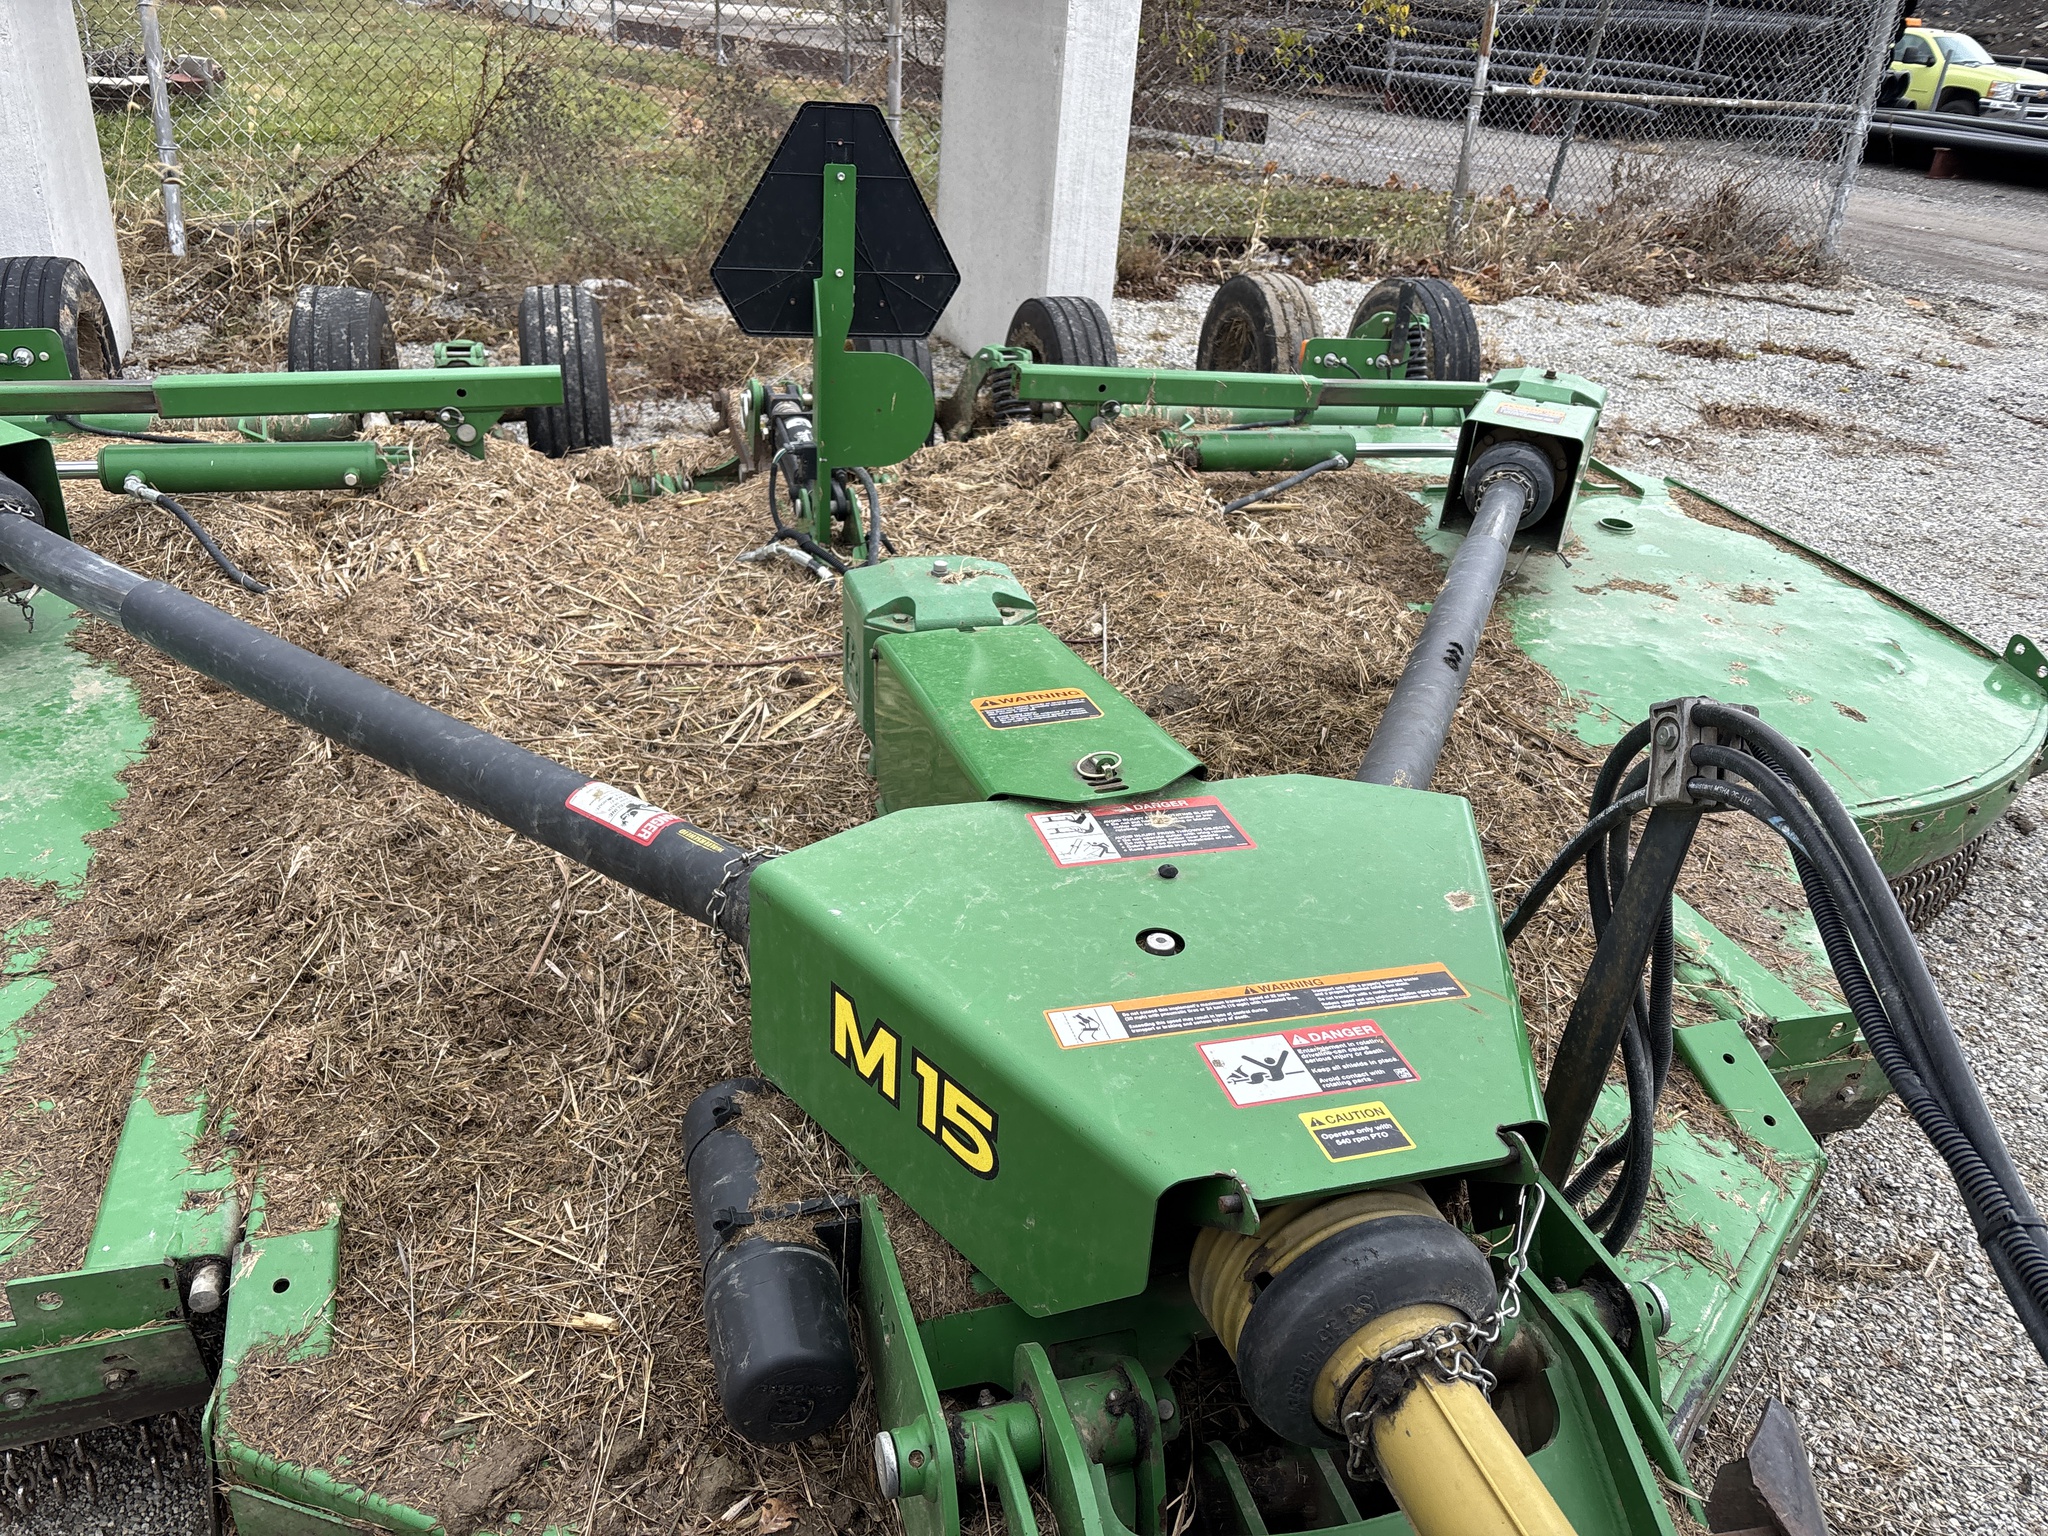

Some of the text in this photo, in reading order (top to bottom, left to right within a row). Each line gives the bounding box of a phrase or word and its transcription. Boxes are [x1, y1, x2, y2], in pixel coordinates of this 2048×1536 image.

[999, 690, 1081, 704] WARNING
[1132, 800, 1189, 810] DANGER
[1257, 978, 1324, 993] WARNING
[1307, 1025, 1376, 1042] DANGER
[1303, 1055, 1333, 1064] serious
[1341, 1061, 1370, 1069] shields
[831, 981, 1000, 1181] M 15
[1318, 1075, 1341, 1083] Avoid
[1340, 1071, 1370, 1080] contact
[1321, 1079, 1352, 1089] rotating
[1323, 1106, 1386, 1124] CAUTION
[1320, 1122, 1394, 1141] Operate only with
[1334, 1131, 1390, 1146] 540 rpm PTO
